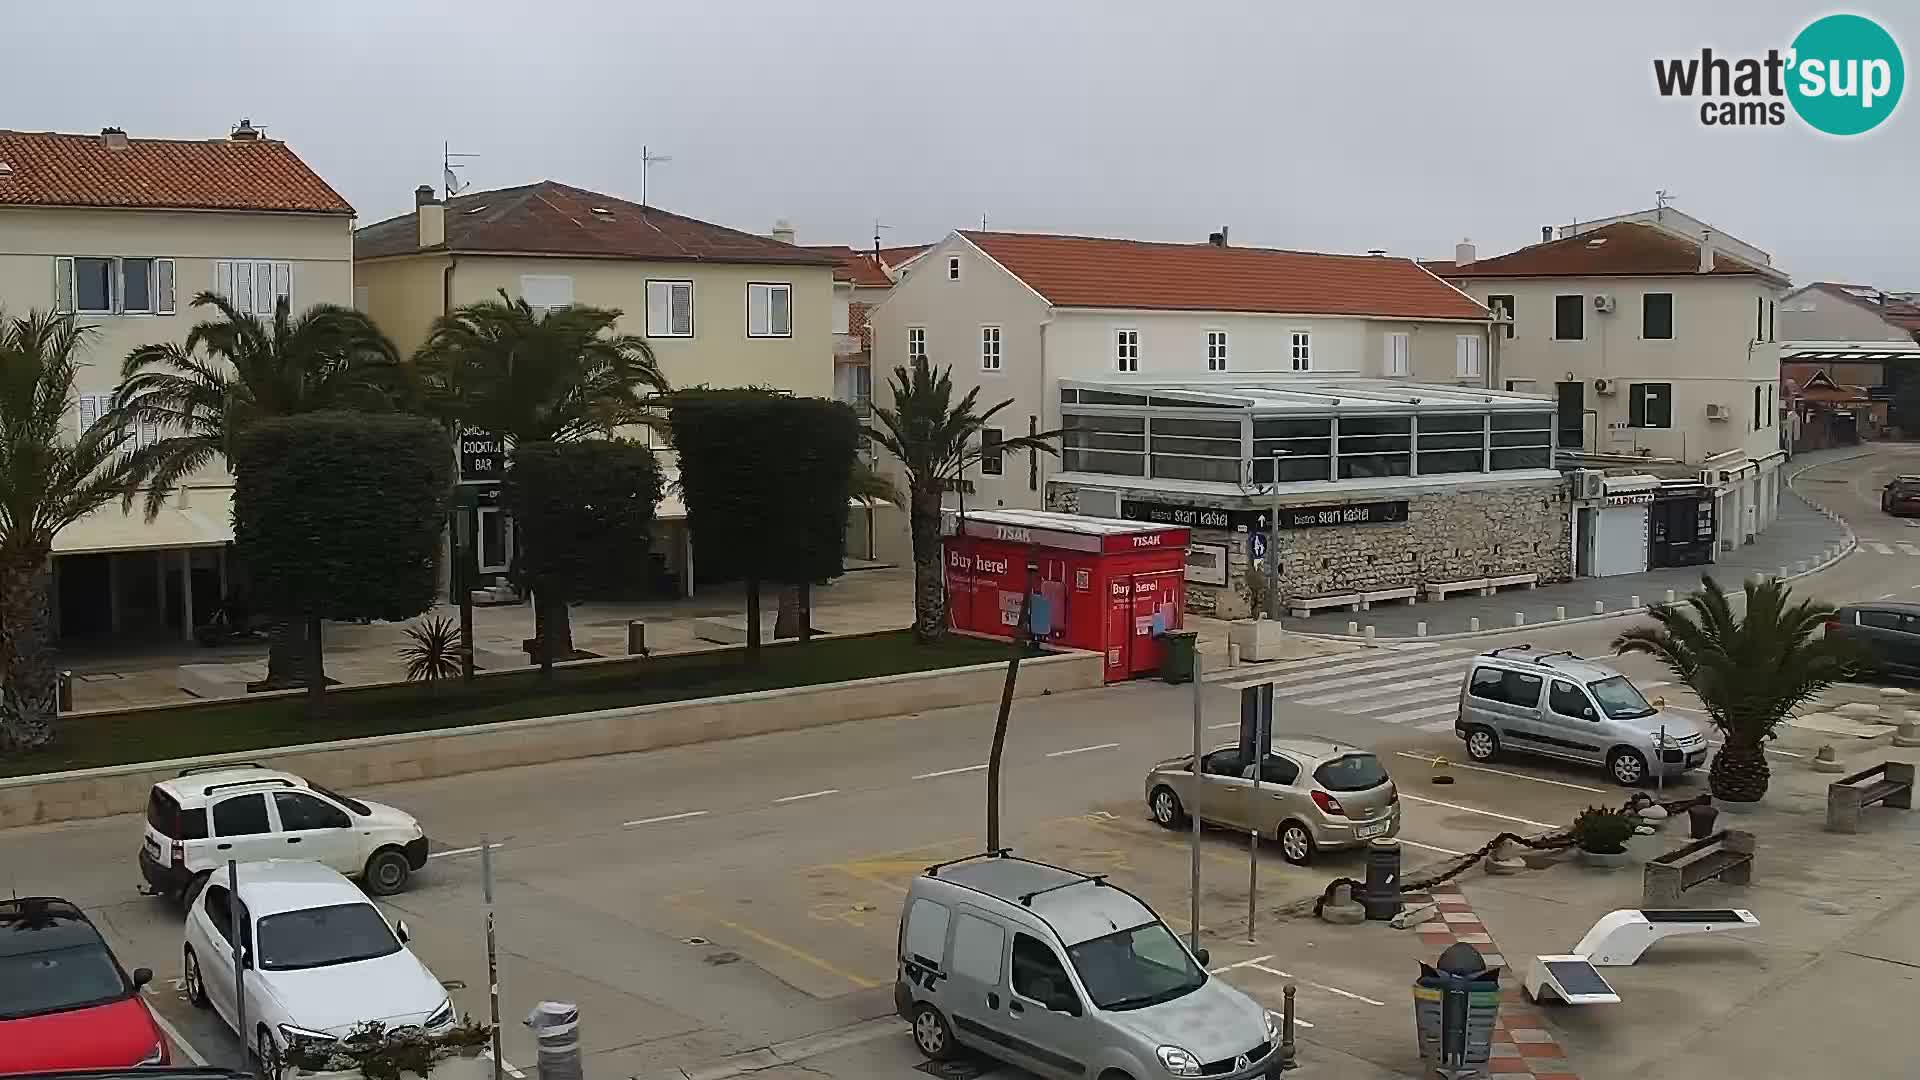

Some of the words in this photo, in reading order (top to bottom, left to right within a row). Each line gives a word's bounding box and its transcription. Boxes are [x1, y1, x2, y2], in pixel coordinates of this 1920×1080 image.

[475, 458, 492, 471] BAR
[1132, 535, 1161, 547] TISAK
[950, 550, 972, 573] Buy
[975, 555, 1008, 574] here!
[1112, 583, 1130, 596] Buy
